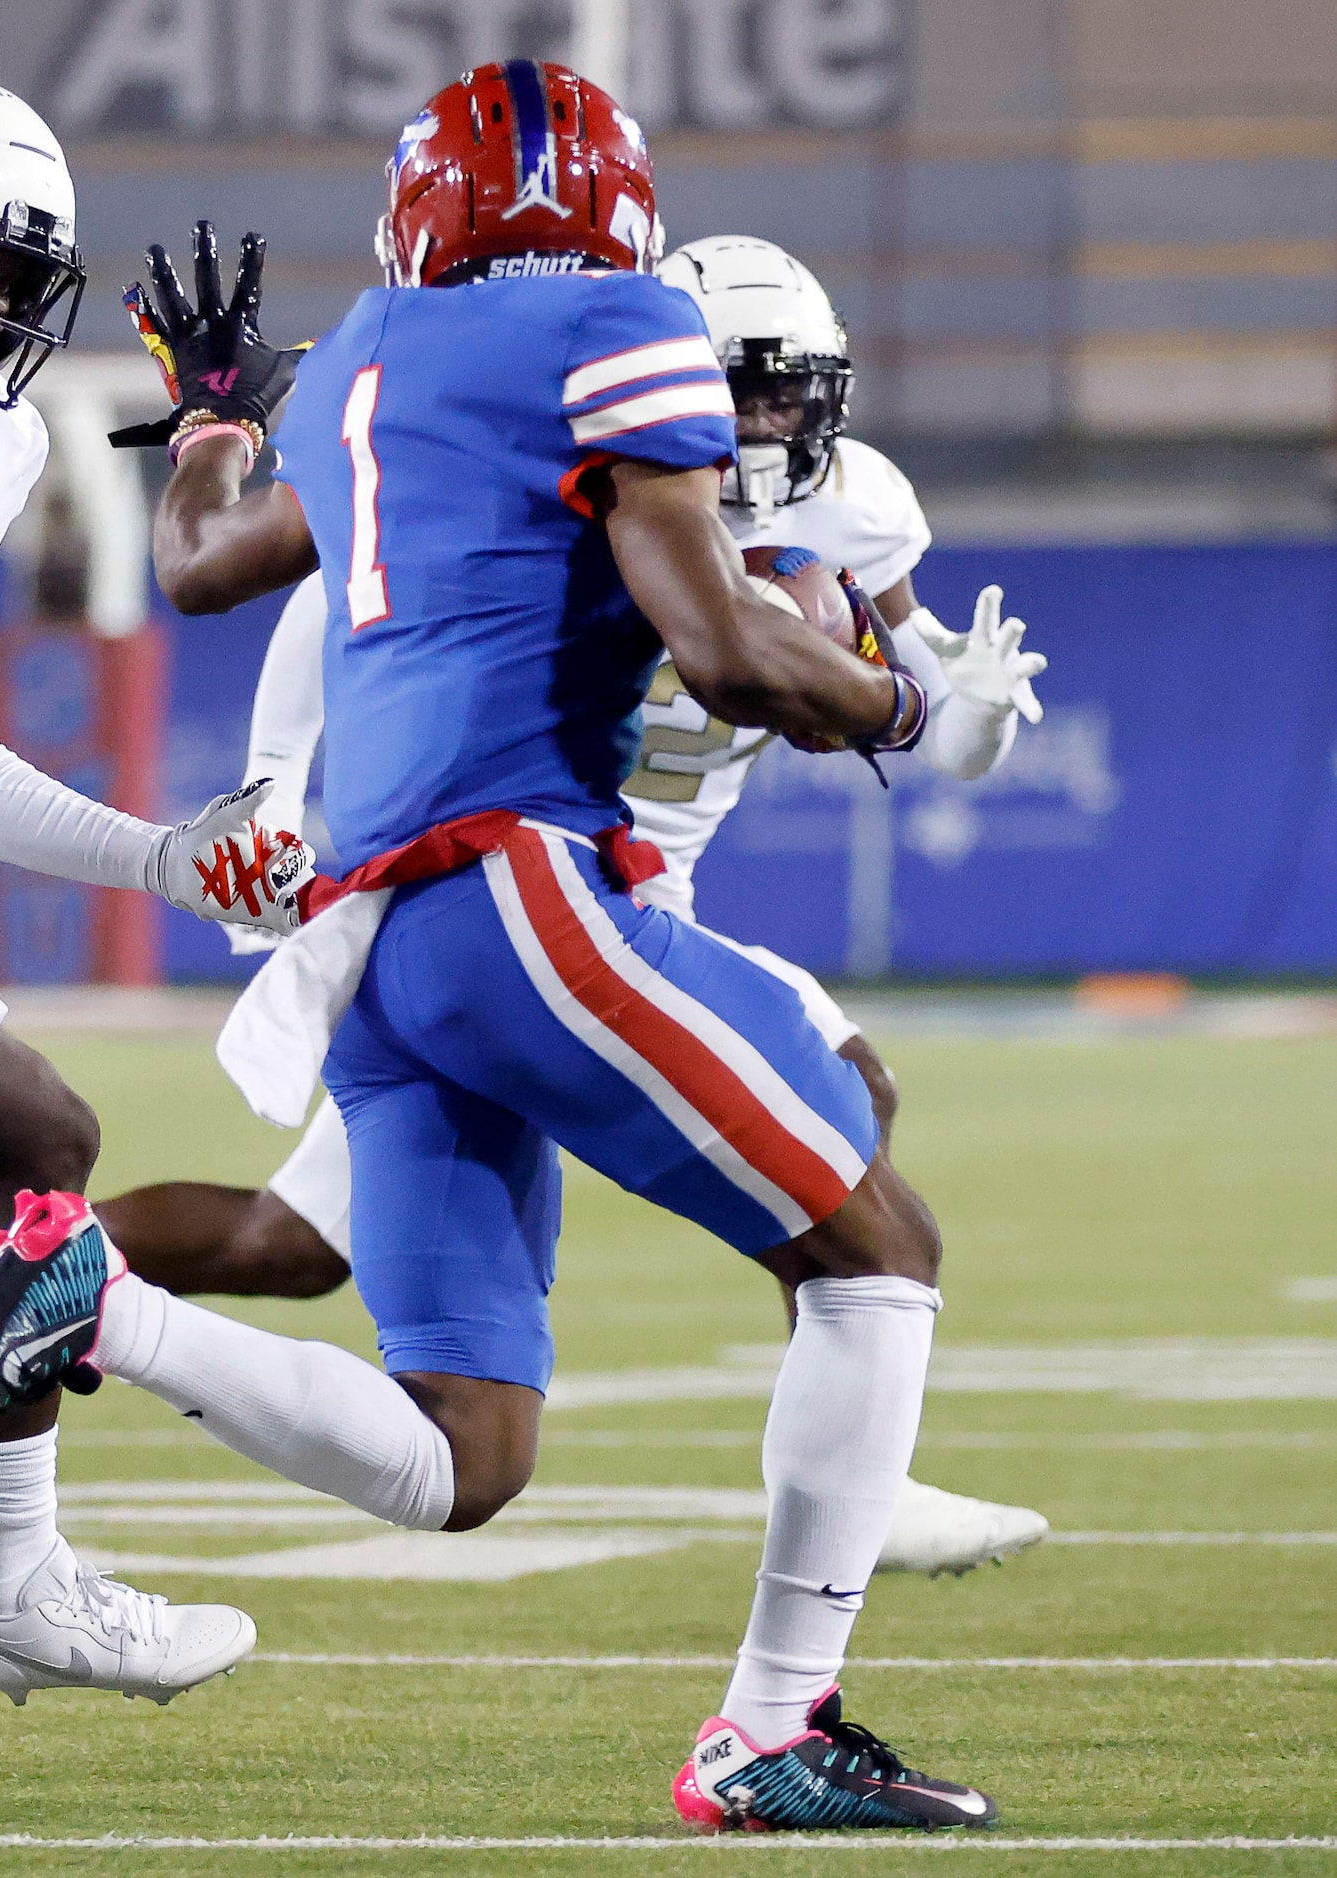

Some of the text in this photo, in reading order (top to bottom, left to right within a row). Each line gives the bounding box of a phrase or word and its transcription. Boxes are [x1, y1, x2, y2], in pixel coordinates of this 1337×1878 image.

[488, 250, 583, 279] schutt
[340, 363, 391, 635] 1
[698, 1736, 733, 1770] NIKE
